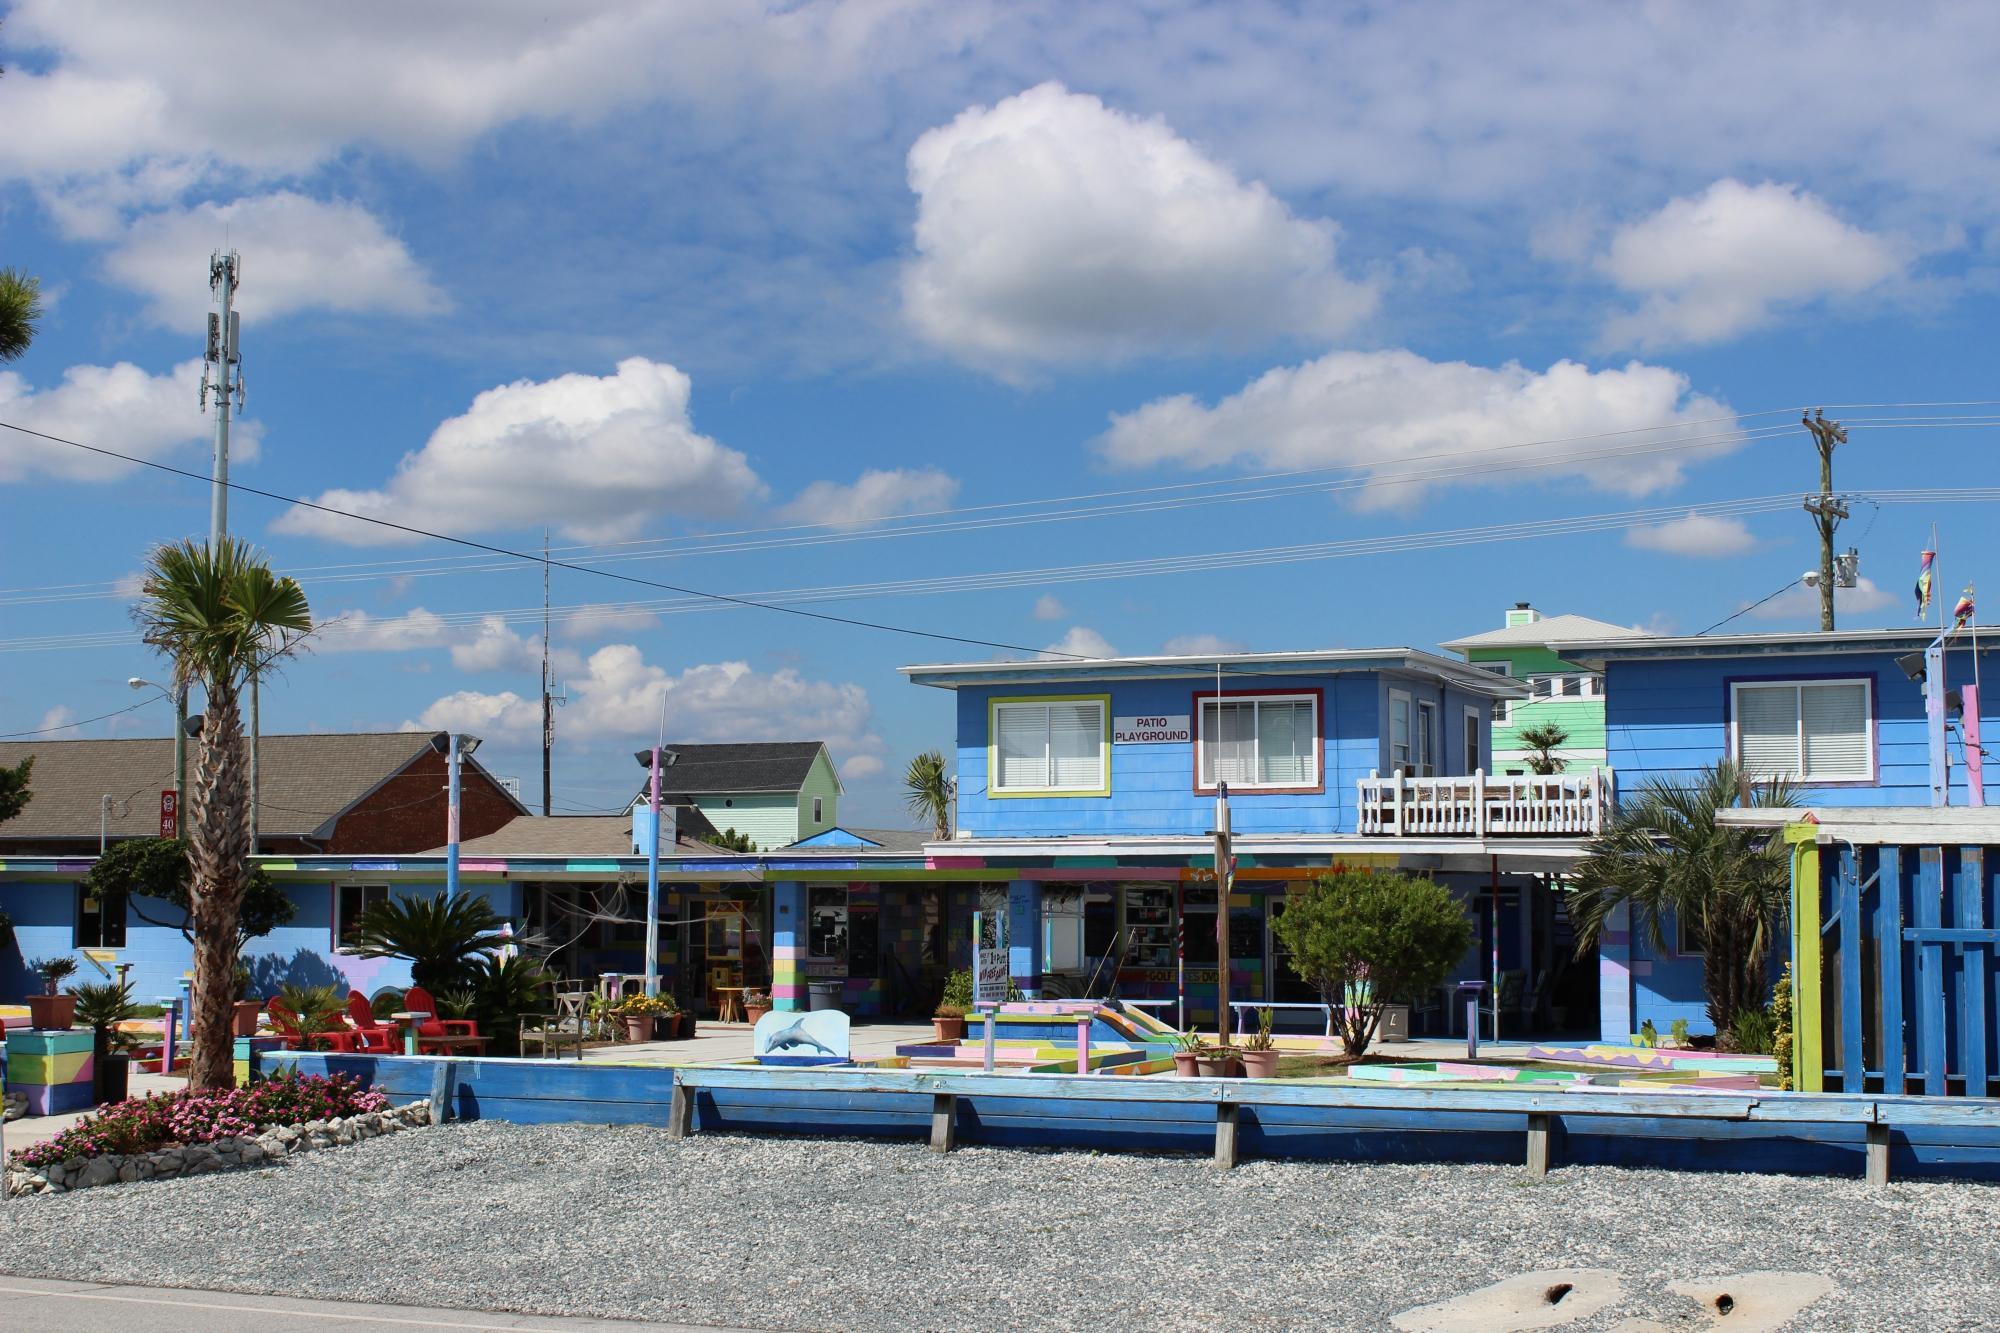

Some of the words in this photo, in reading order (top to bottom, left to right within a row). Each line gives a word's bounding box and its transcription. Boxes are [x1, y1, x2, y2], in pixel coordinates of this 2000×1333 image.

[1136, 717, 1168, 728] PATIO
[1115, 730, 1188, 742] PLAYGROUND
[162, 819, 174, 830] 40
